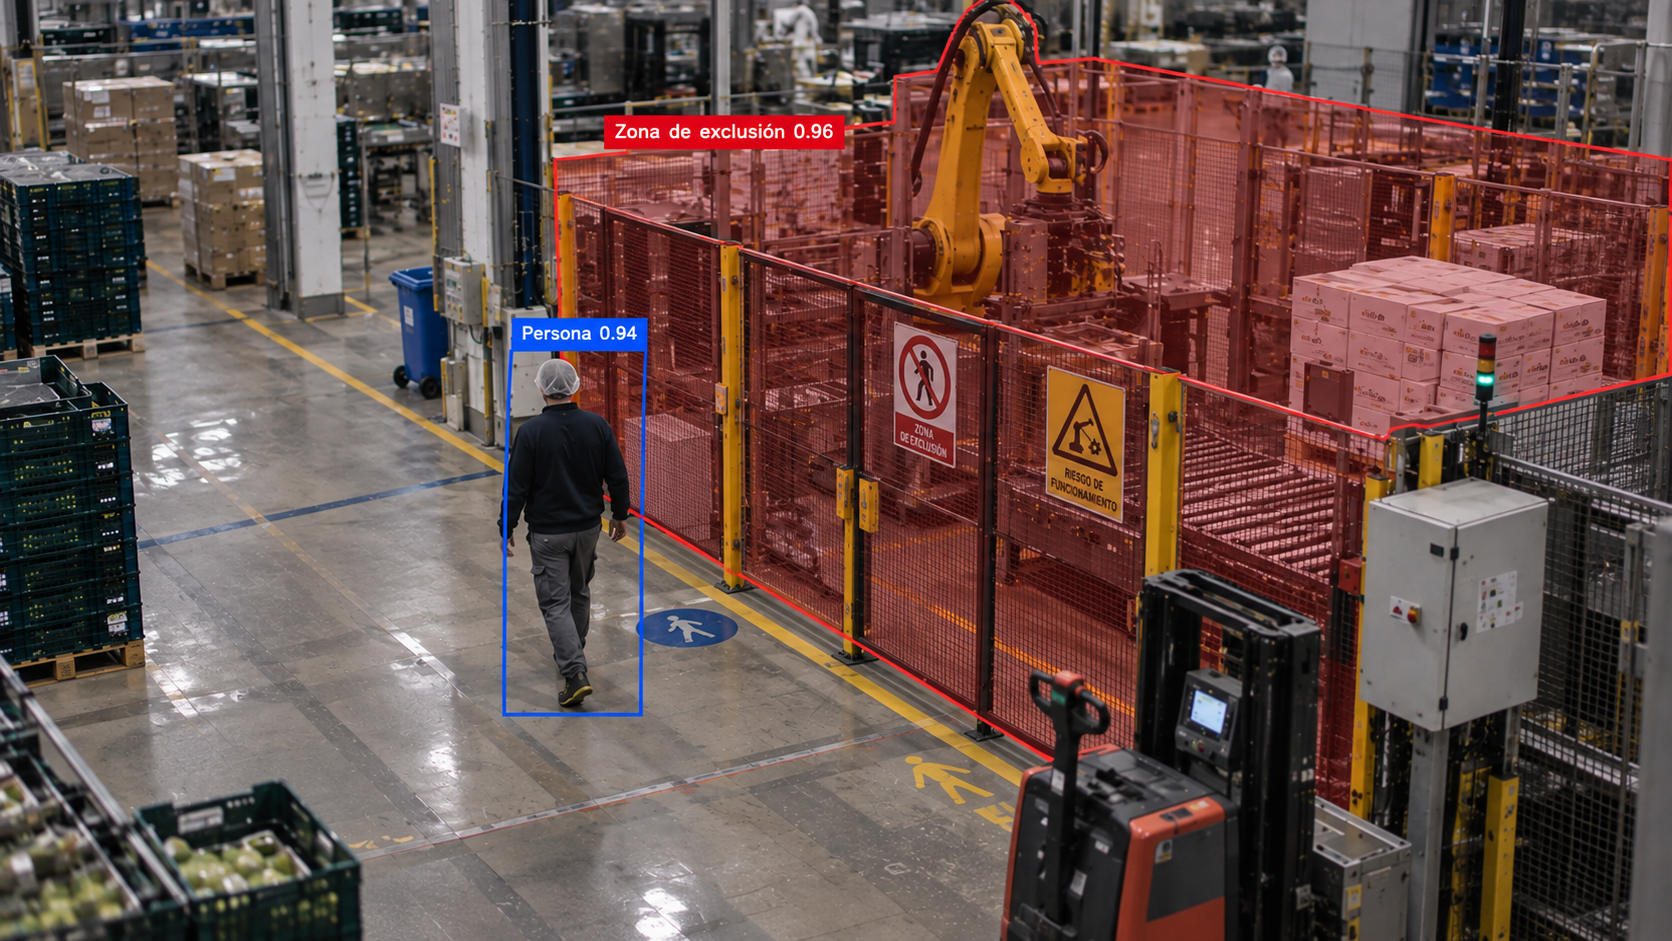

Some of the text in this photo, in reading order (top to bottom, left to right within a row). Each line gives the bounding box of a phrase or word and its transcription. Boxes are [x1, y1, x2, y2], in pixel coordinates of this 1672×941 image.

[900, 431, 909, 444] DE
[914, 423, 935, 440] ZONA
[1064, 467, 1104, 492] RIESGO DE
[1050, 477, 1118, 512] FUNCIONAMIENTO
